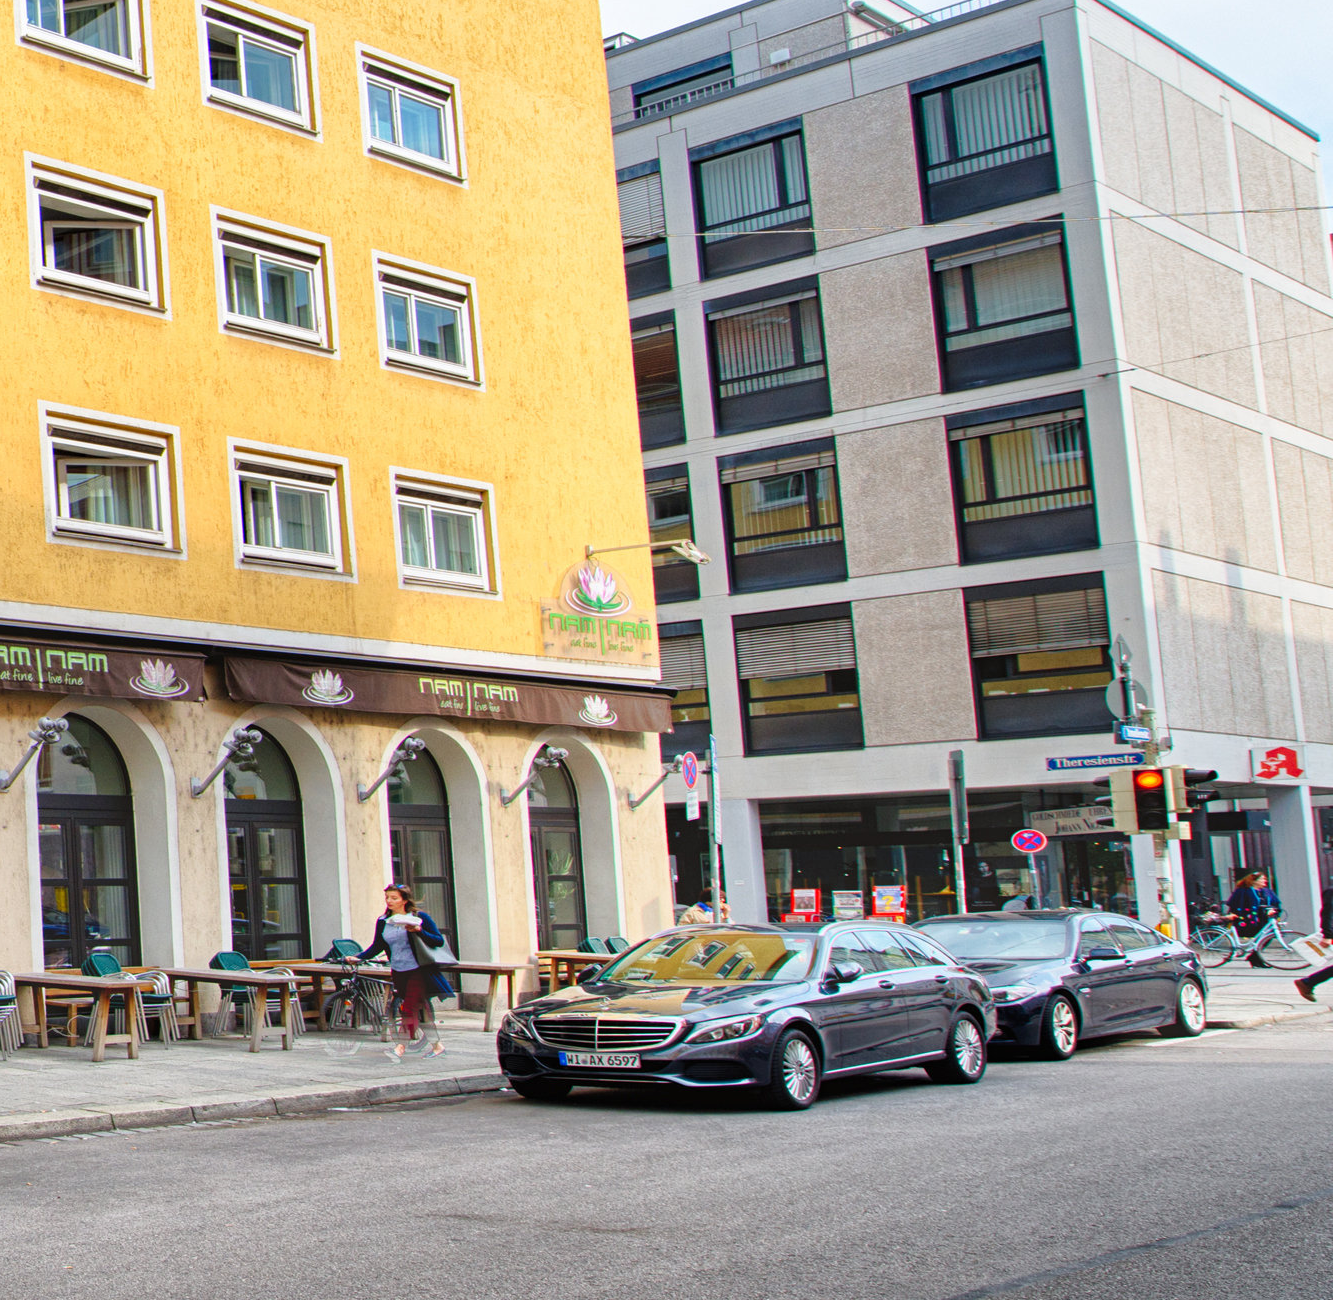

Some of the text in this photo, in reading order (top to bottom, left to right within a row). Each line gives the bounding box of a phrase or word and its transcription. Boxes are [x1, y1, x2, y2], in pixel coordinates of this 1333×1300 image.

[549, 613, 652, 640] NAM NAM
[46, 650, 109, 673] NAM
[13, 668, 33, 682] fine
[48, 672, 62, 684] live
[64, 672, 83, 685] fine
[419, 677, 518, 702] NAM NAM
[1055, 755, 1138, 768] Theresienstr.
[567, 1054, 637, 1066] WI AX 6597
